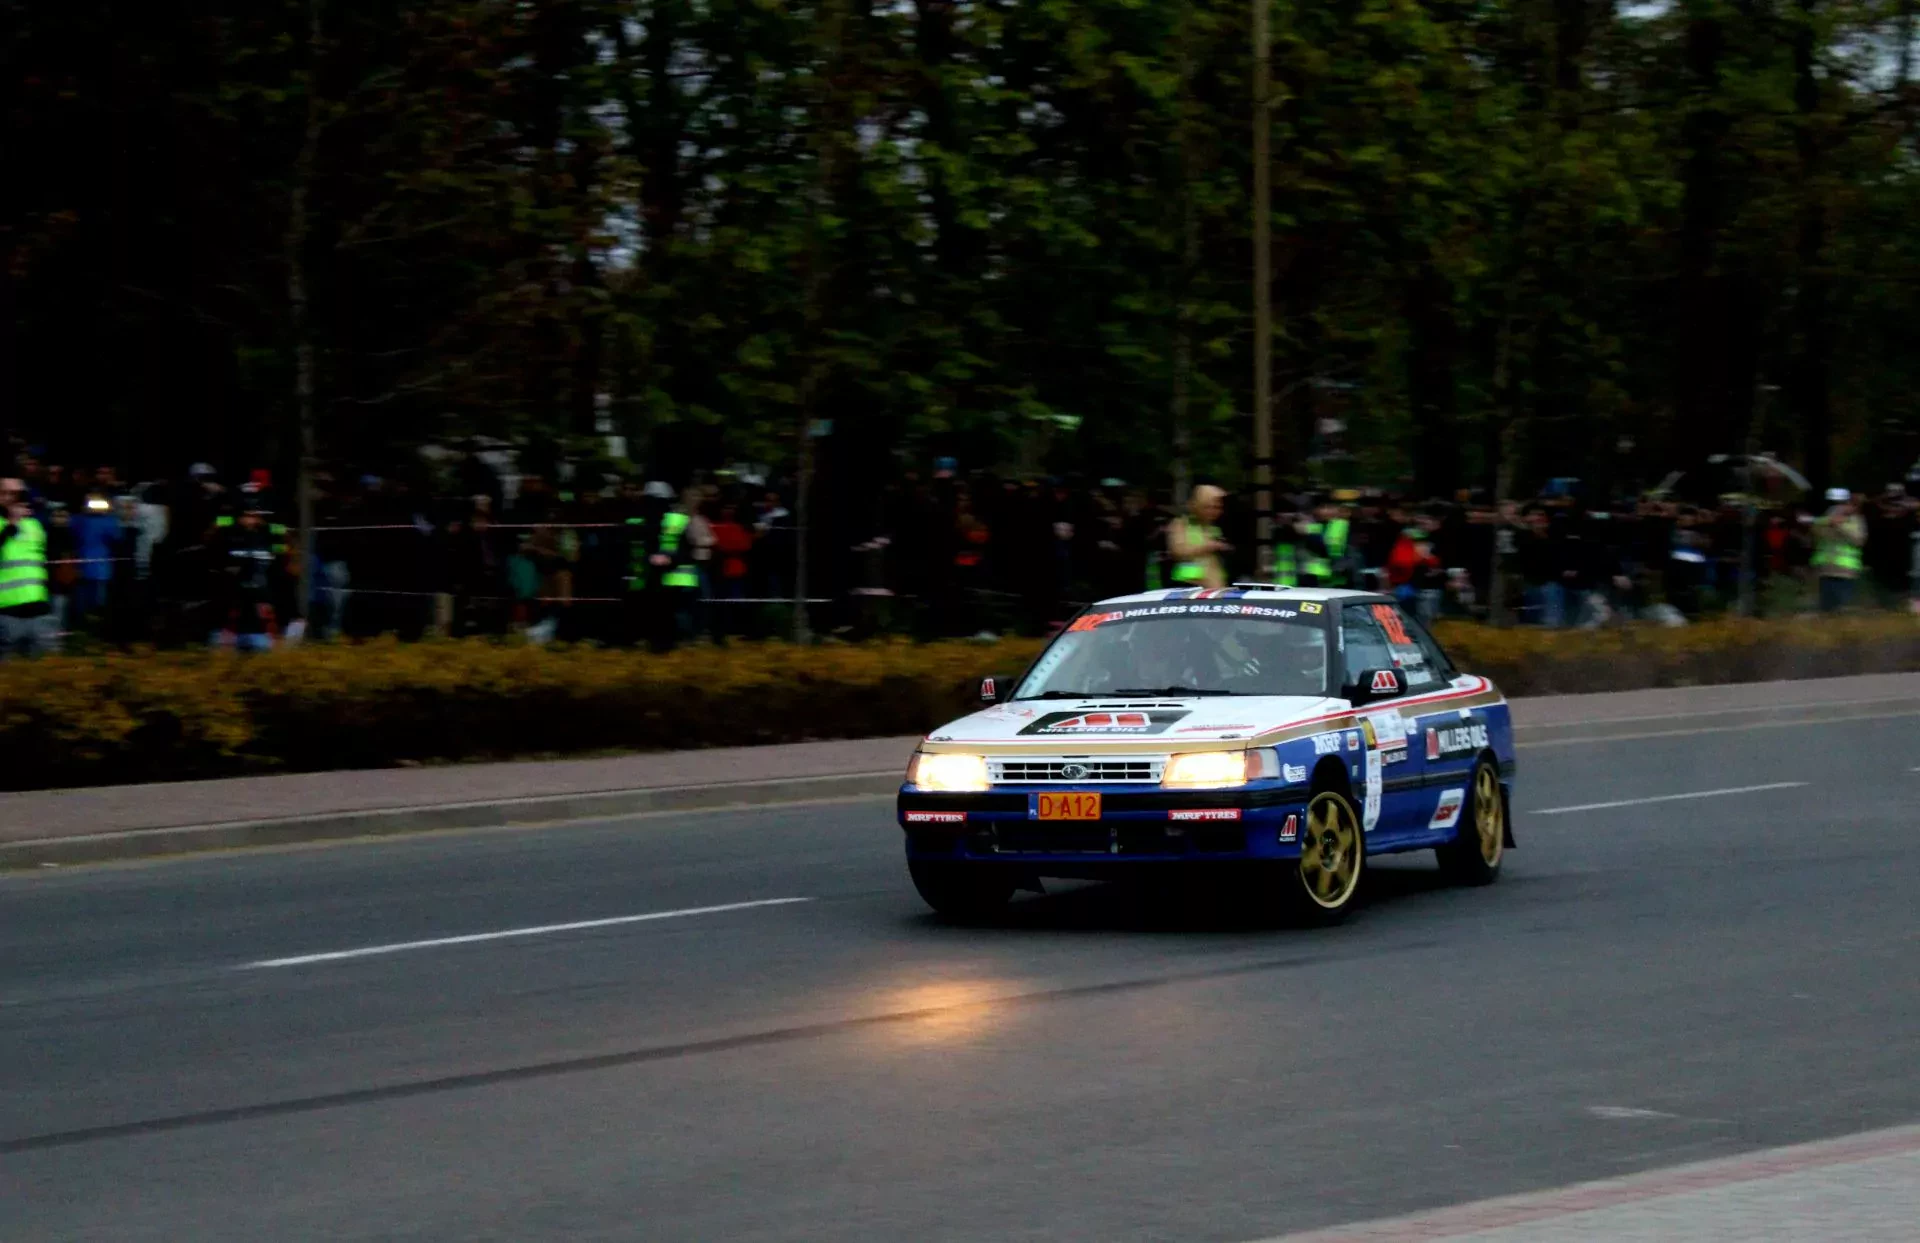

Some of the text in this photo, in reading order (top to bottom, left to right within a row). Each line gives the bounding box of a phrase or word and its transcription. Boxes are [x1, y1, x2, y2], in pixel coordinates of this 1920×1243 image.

[1125, 604, 1297, 618] MILLERS OILS HRSMP
[1438, 727, 1472, 753] MILLERS
[1040, 796, 1097, 817] D A12
[933, 813, 964, 822] TYRES
[1204, 810, 1238, 820] TYRES
